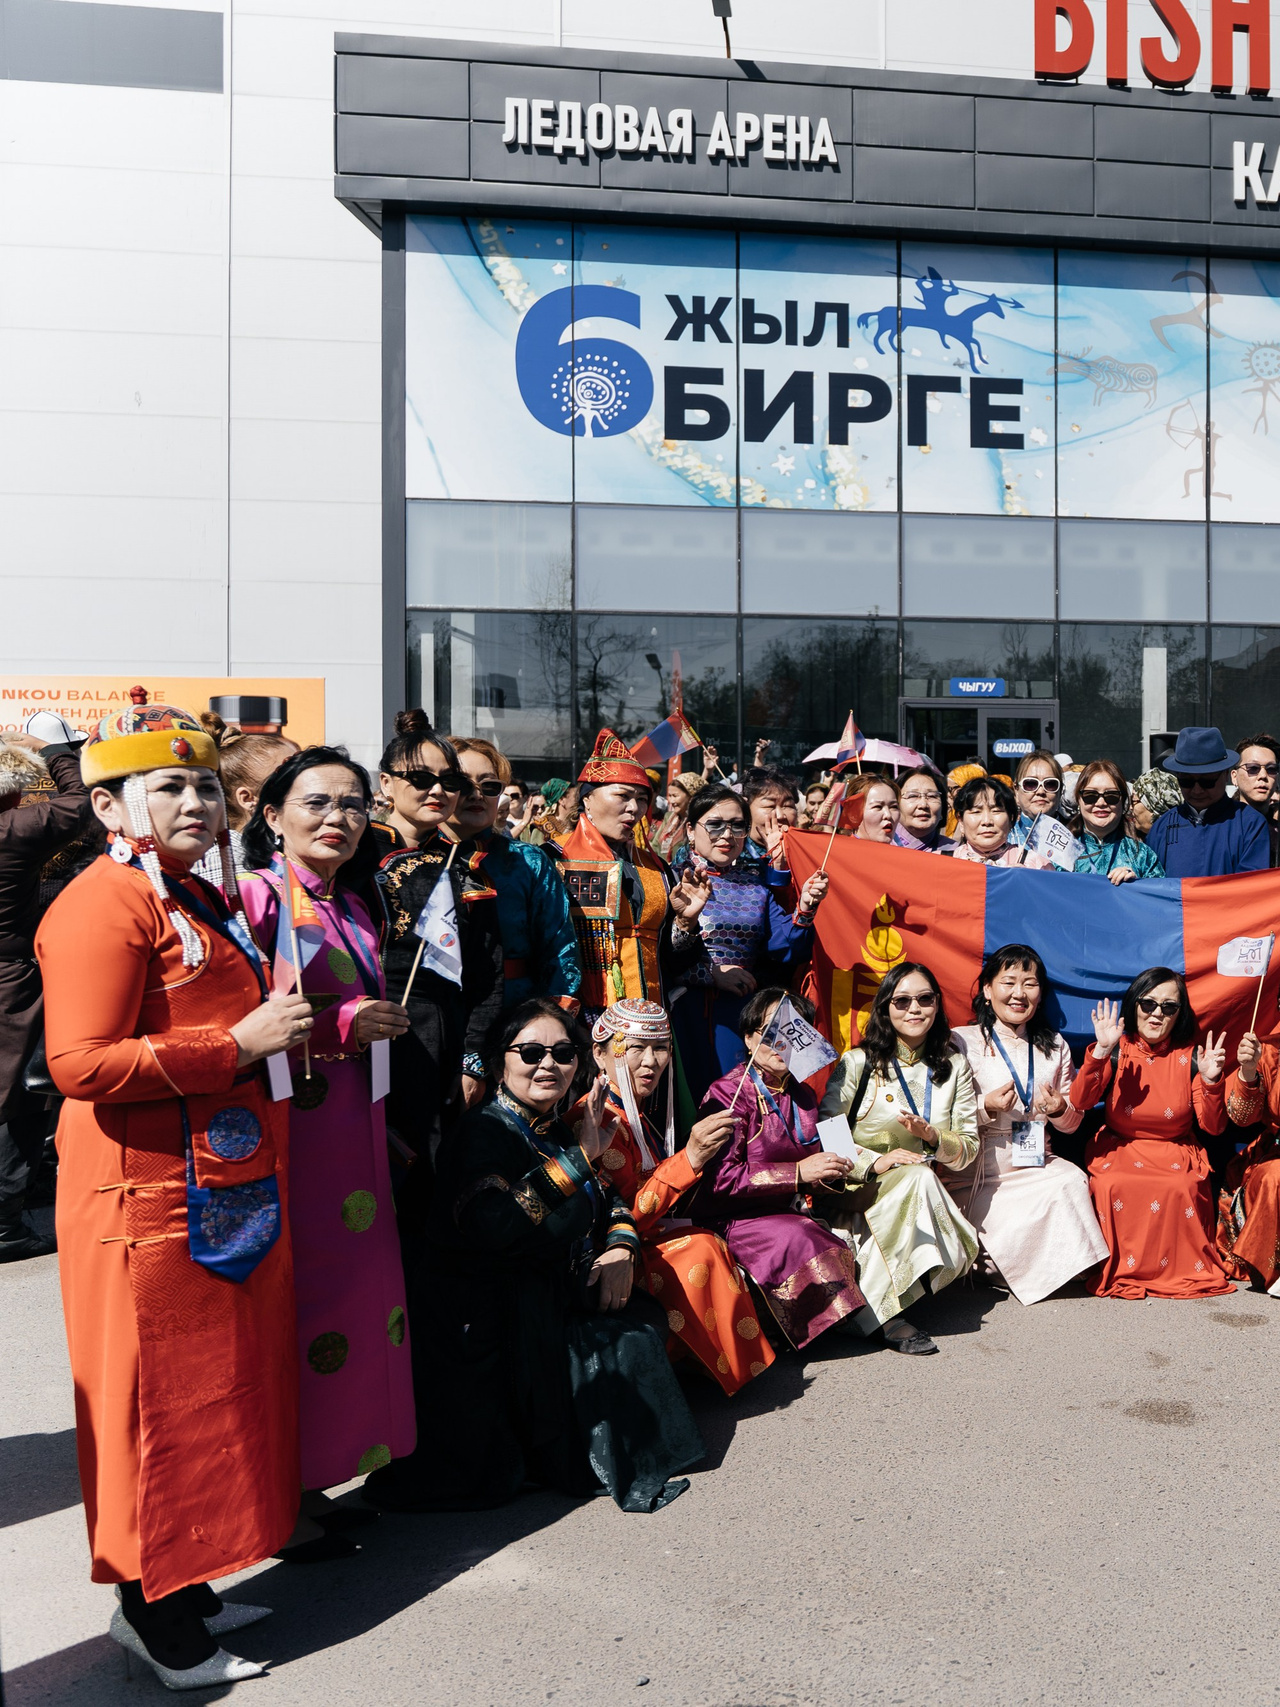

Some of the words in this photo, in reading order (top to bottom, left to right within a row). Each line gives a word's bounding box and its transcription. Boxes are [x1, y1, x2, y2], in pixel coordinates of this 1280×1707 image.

[502, 97, 694, 157] ЛЕДОВАЯ
[707, 111, 839, 165] АРЕНА
[515, 284, 654, 438] 6
[664, 294, 850, 348] ЖЫЛ
[664, 366, 1024, 450] БИРГЕ
[958, 682, 996, 692] ЧЫГУУ
[1, 689, 61, 701] NKOU
[67, 690, 165, 702] BALANE
[22, 707, 82, 718] МЕН
[995, 743, 1032, 753] ВЫХОД
